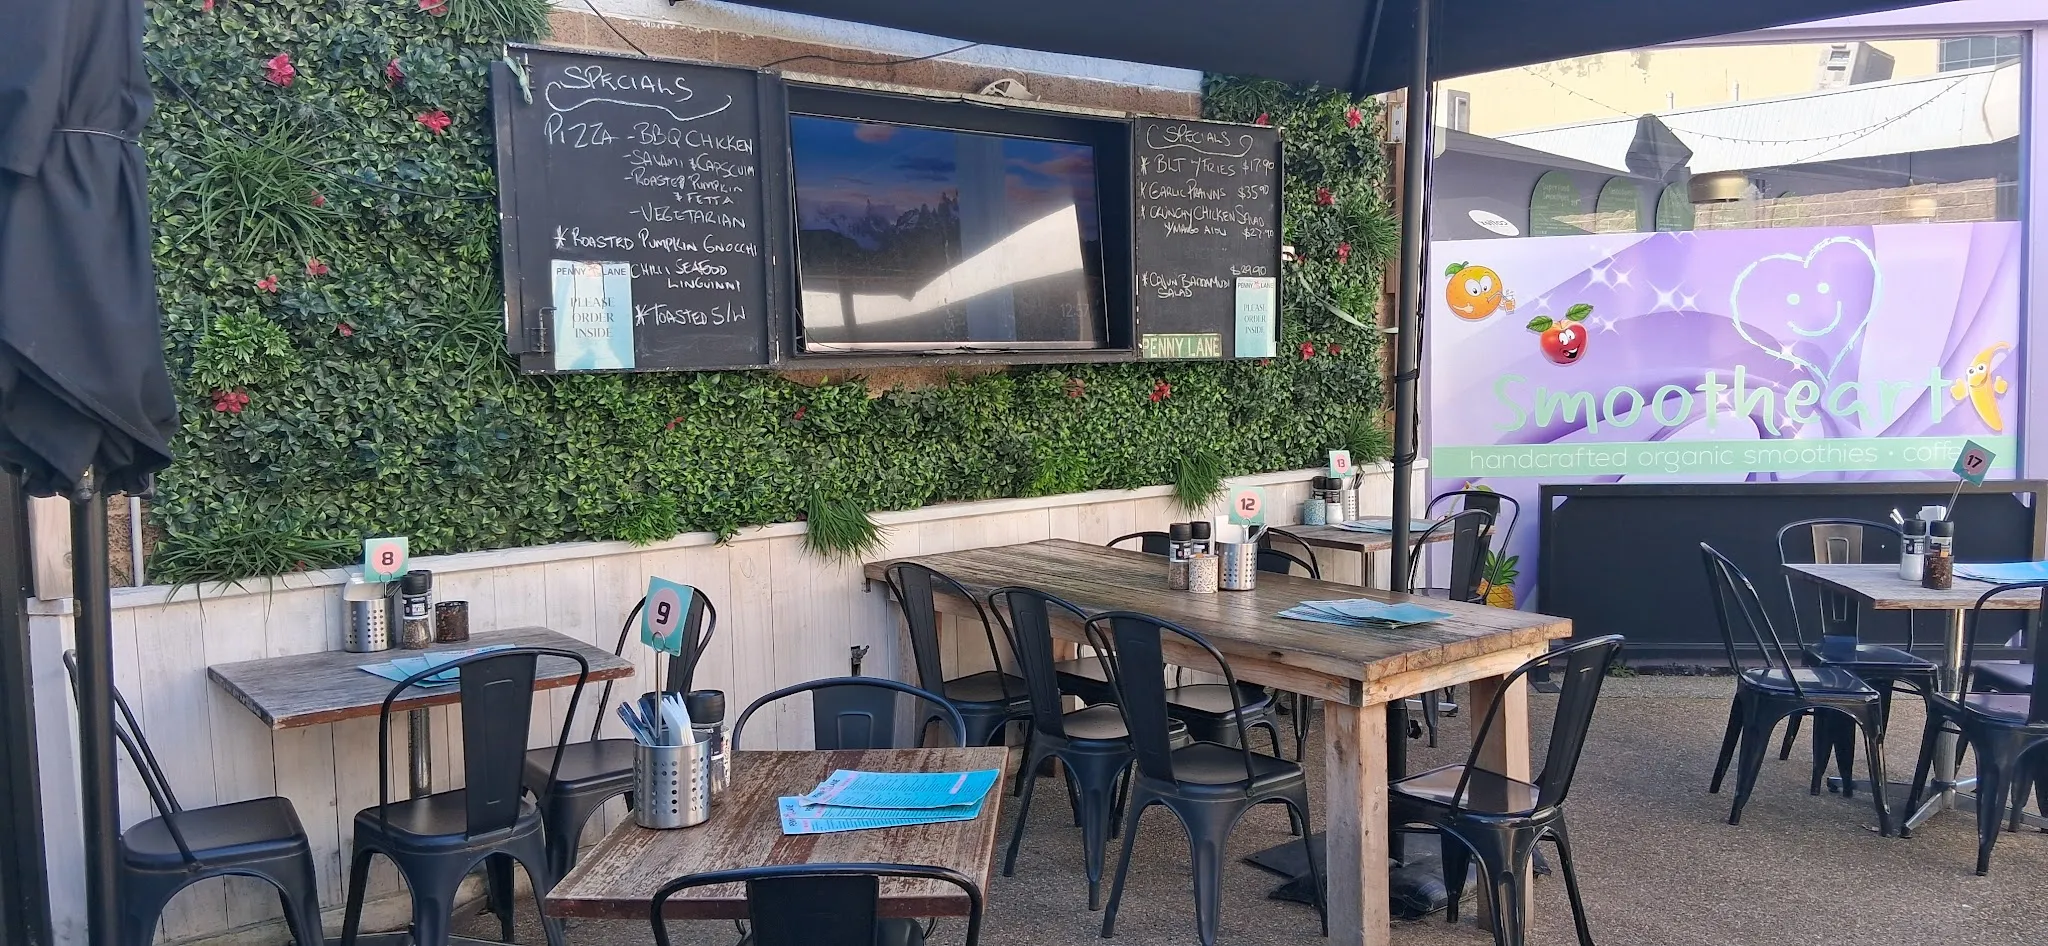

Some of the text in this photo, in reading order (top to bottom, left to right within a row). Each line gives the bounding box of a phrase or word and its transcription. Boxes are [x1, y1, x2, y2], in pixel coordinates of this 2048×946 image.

[558, 65, 693, 103] SPECIALS
[544, 112, 753, 155] PIZZA BBQ CHICKEN
[1163, 123, 1231, 147] SPECIALS
[629, 150, 684, 169] SALAMI
[1154, 153, 1187, 174] BLT
[1149, 181, 1186, 200] GARLIC
[1185, 178, 1227, 201] PRAWNS
[687, 192, 734, 205] FETTA
[640, 203, 746, 229] VEGETARIAN
[1194, 205, 1235, 222] CHICKEN
[1234, 205, 1265, 227] SALAD
[571, 226, 758, 257] ROASTED PUMPKIN GNOCCHI
[556, 267, 627, 276] PENNY LANE
[675, 258, 728, 277] SEAFOOD
[1158, 287, 1193, 299] SALAD
[570, 297, 615, 309] PLEASE
[1060, 303, 1089, 318] 12:57
[1243, 304, 1267, 312] PLEASE
[573, 313, 615, 323] ORDER
[650, 302, 707, 326] TOASTED
[1244, 315, 1266, 323] ORDER
[575, 328, 613, 338] INSIDE
[1245, 326, 1264, 334] INSIDE
[1143, 337, 1221, 358] PENNY LANE
[1336, 458, 1346, 468] 13
[1470, 446, 1628, 471] handcrafted
[1639, 445, 1733, 472] organic
[1745, 441, 1878, 467] smoothies
[1967, 455, 1982, 468] 17
[1240, 498, 1255, 511] 12
[381, 552, 394, 565] 8
[656, 601, 671, 625] 9
